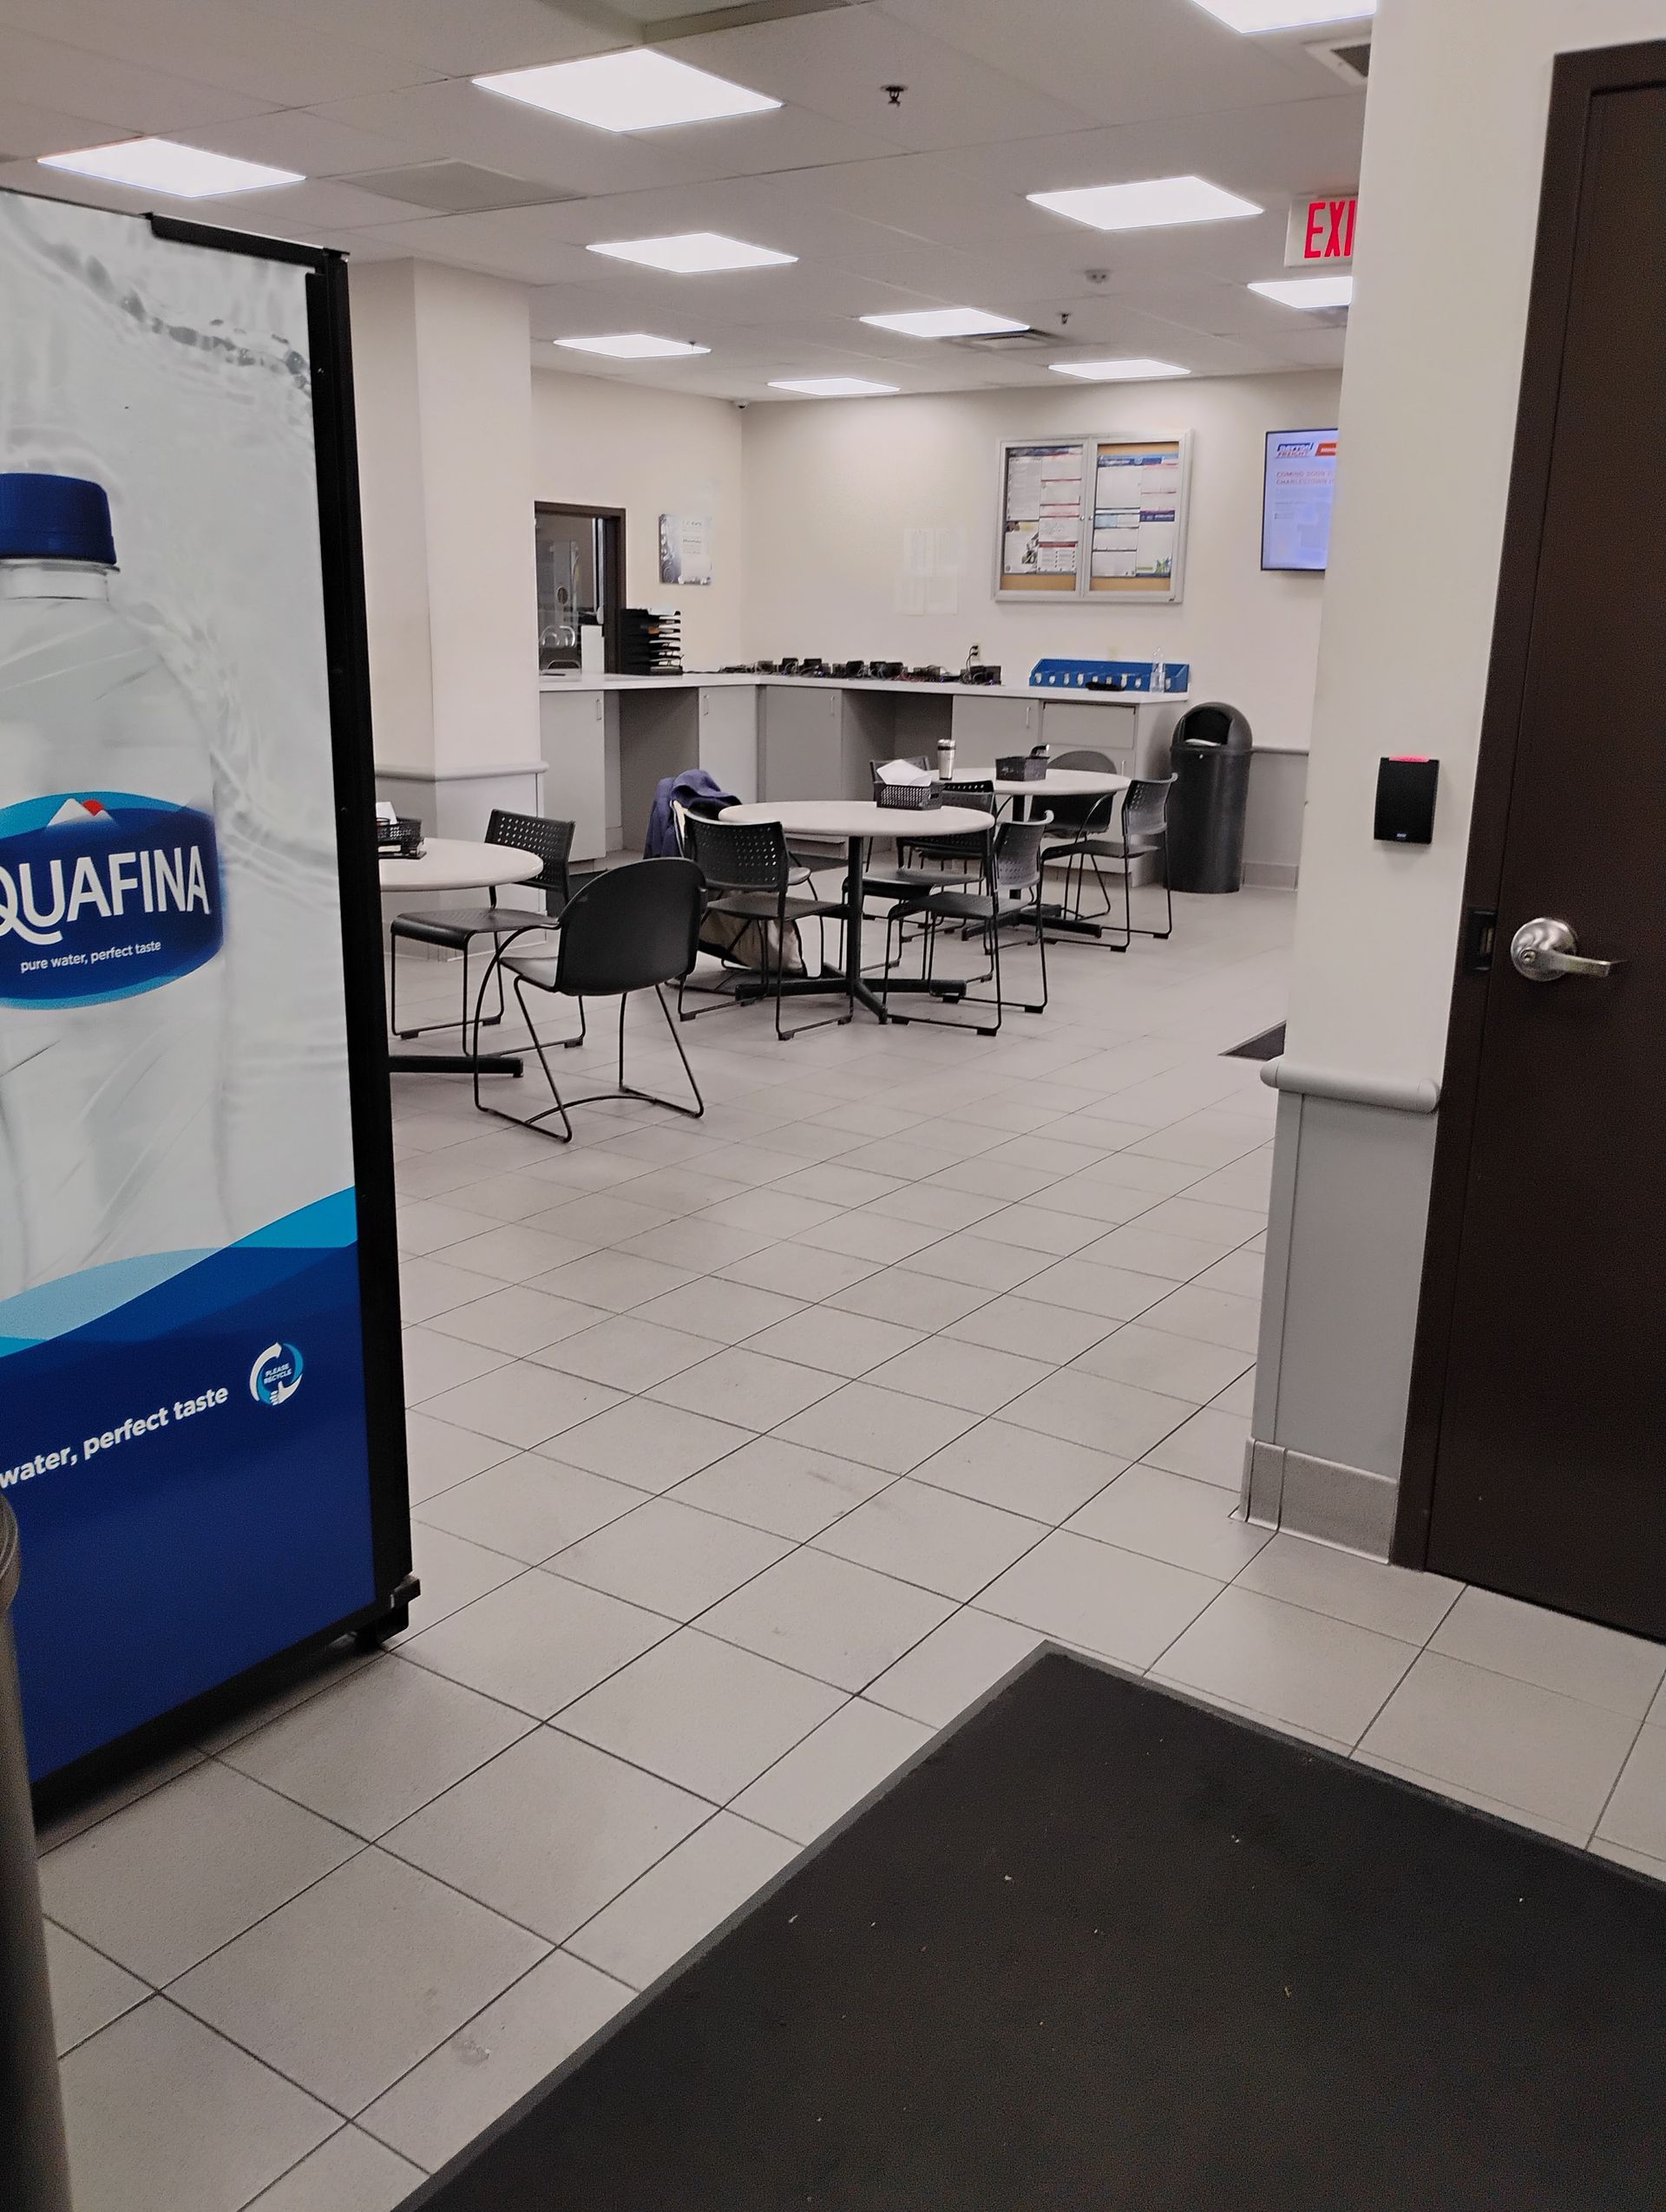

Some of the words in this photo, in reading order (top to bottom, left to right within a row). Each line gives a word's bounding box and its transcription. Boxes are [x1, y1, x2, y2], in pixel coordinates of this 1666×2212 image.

[1303, 199, 1356, 259] EXI
[20, 960, 49, 974] pure
[50, 953, 88, 968] water,
[90, 945, 134, 965] perfect
[134, 940, 161, 954] taste
[264, 1368, 292, 1384] RECYCLE
[265, 1363, 290, 1377] PLEASE
[0, 1446, 78, 1489] water,
[83, 1407, 169, 1460] perfect
[174, 1387, 229, 1421] taste
